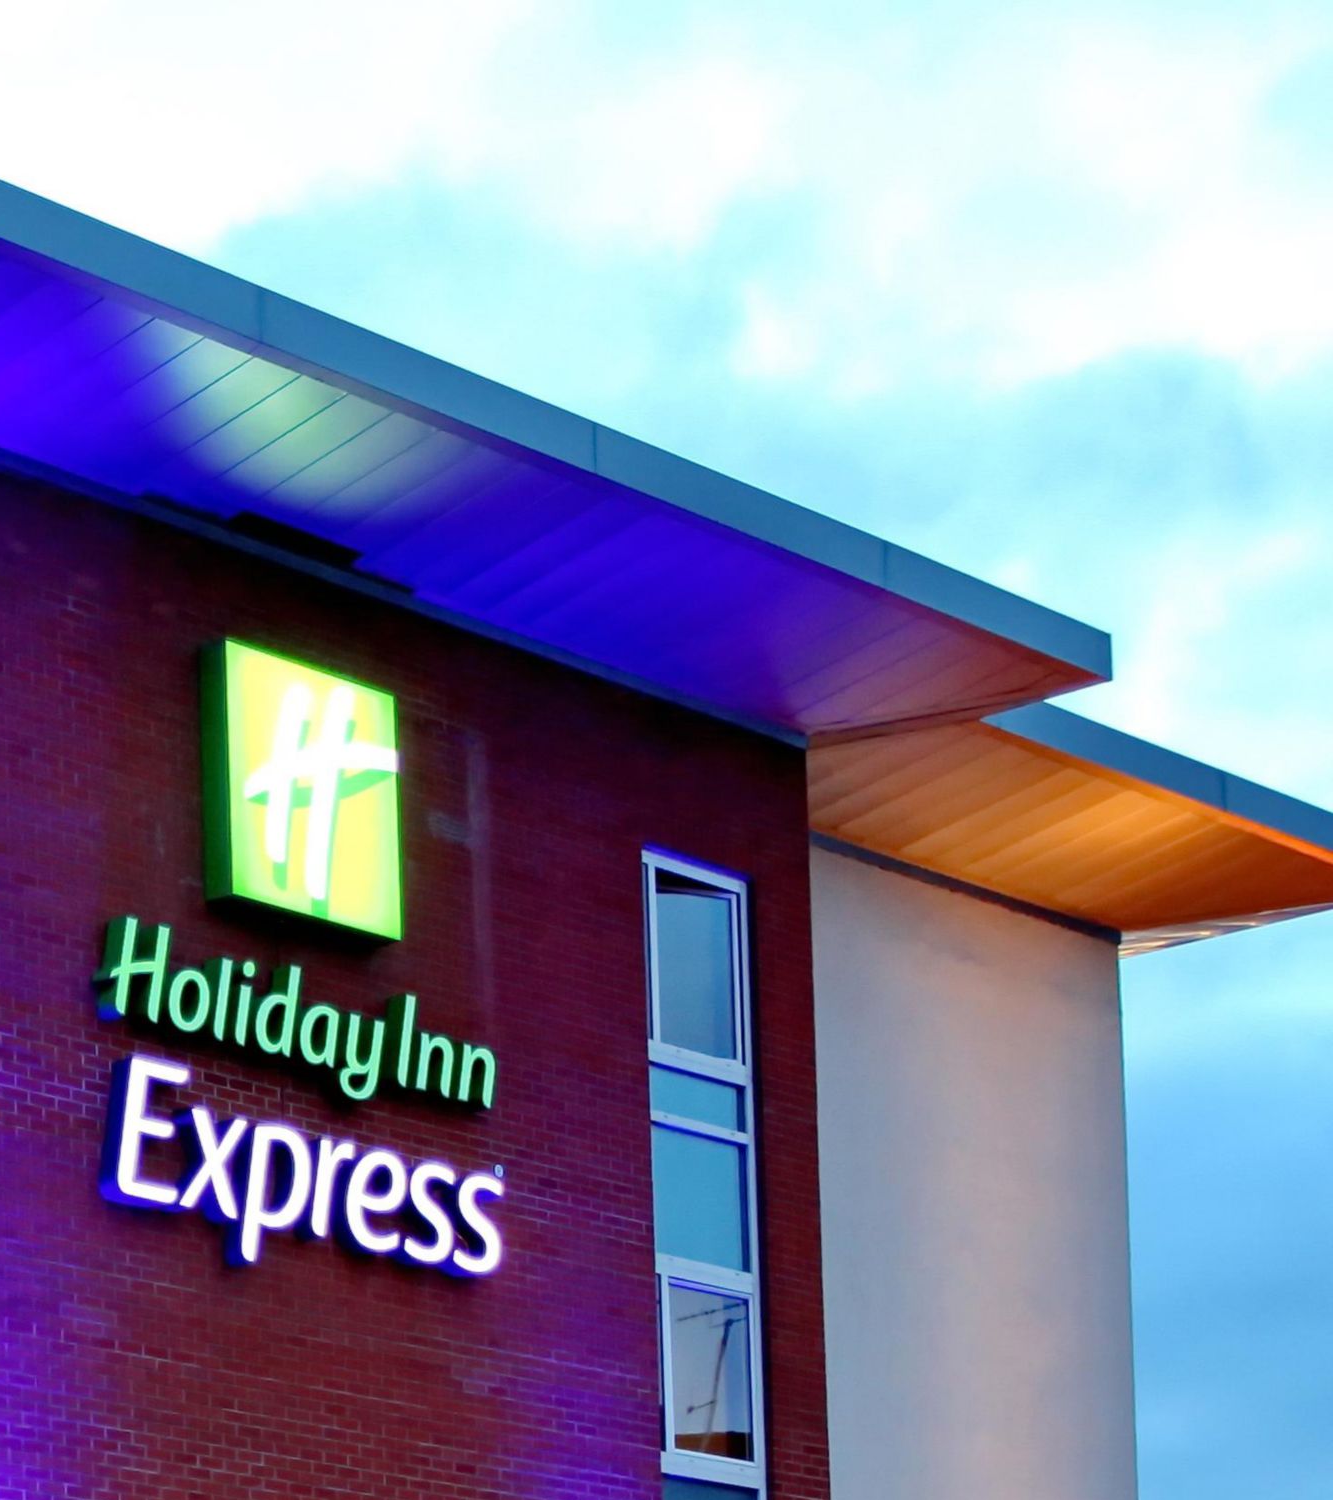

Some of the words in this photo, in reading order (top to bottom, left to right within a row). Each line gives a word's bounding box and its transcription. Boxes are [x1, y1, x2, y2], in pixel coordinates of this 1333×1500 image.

[107, 916, 385, 1101] Holiday
[394, 993, 498, 1109] Inn
[113, 1054, 504, 1274] Express
